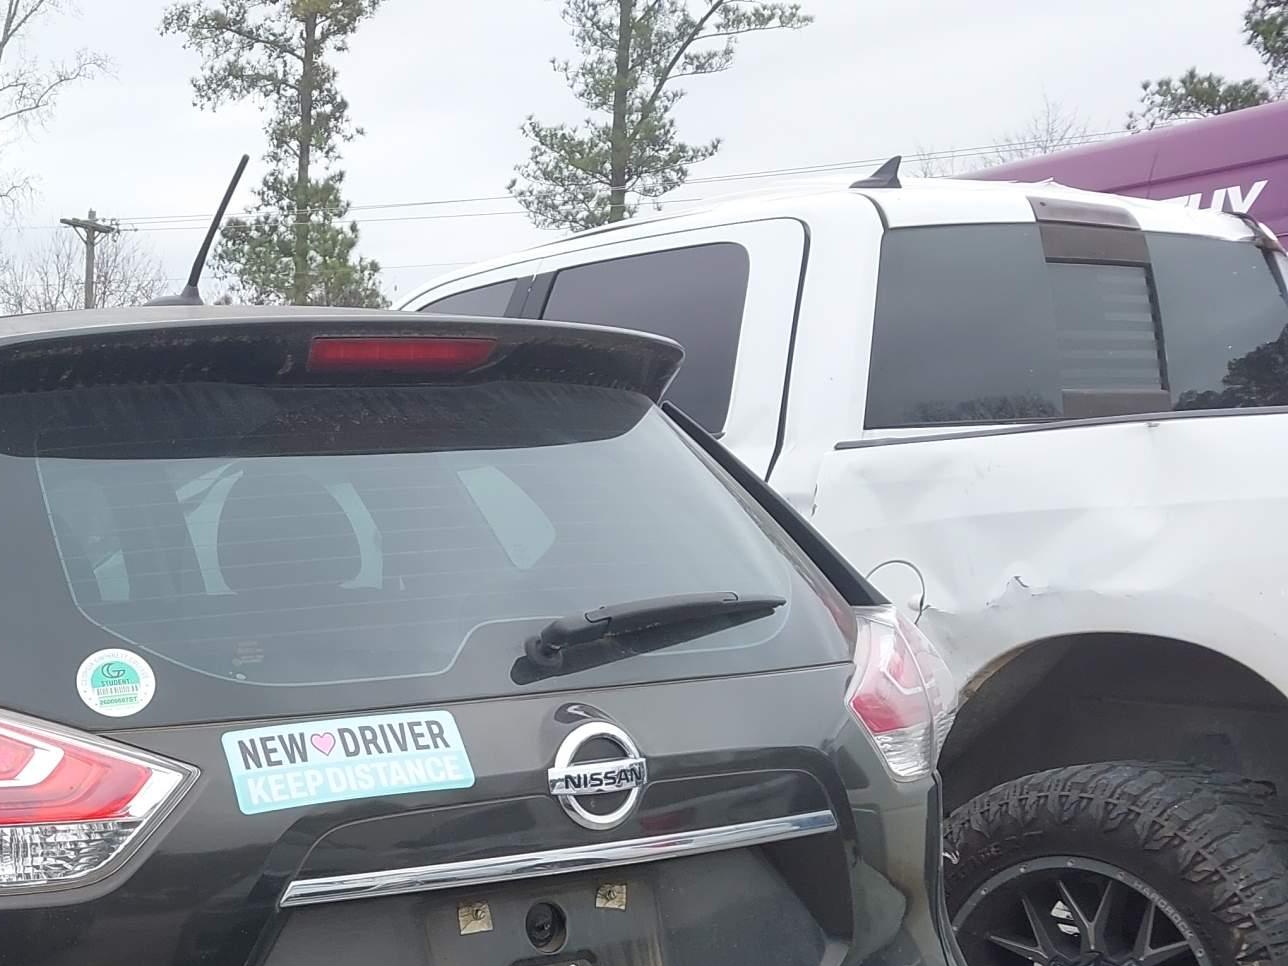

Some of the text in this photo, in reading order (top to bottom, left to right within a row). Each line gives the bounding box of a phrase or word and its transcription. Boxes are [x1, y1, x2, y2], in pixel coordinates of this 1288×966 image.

[101, 679, 130, 687] STUDENT
[237, 720, 451, 770] NEW DRIVER
[246, 755, 463, 805] KEEP DISTANCE
[564, 766, 642, 789] NISSAN
